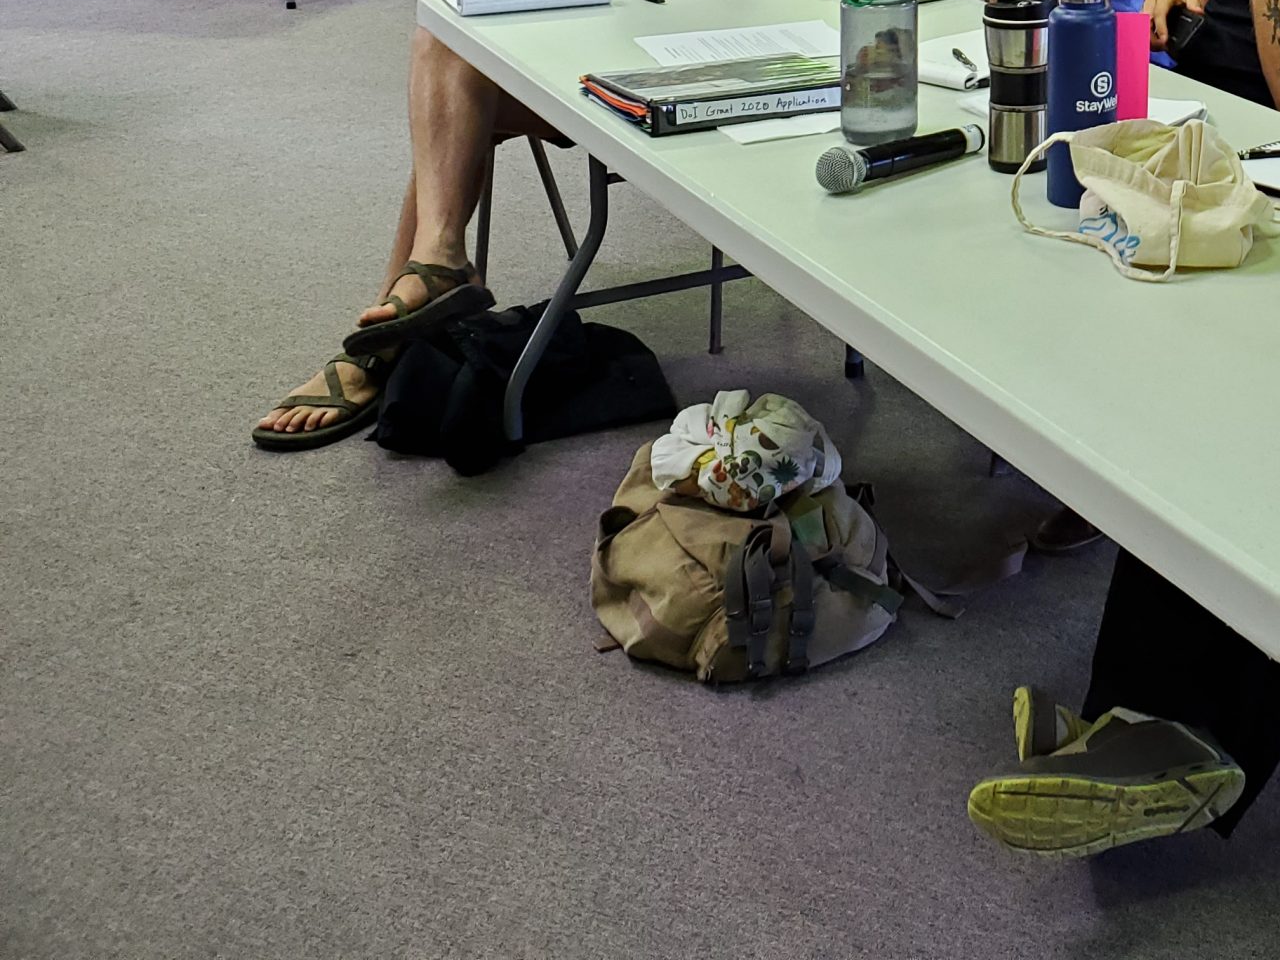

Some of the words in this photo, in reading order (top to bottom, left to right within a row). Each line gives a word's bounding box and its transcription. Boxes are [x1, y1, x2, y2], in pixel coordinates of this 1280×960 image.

[705, 104, 733, 118] Grant
[741, 101, 770, 112] 2020
[776, 96, 827, 111] Application
[1076, 94, 1118, 114] StayWel
